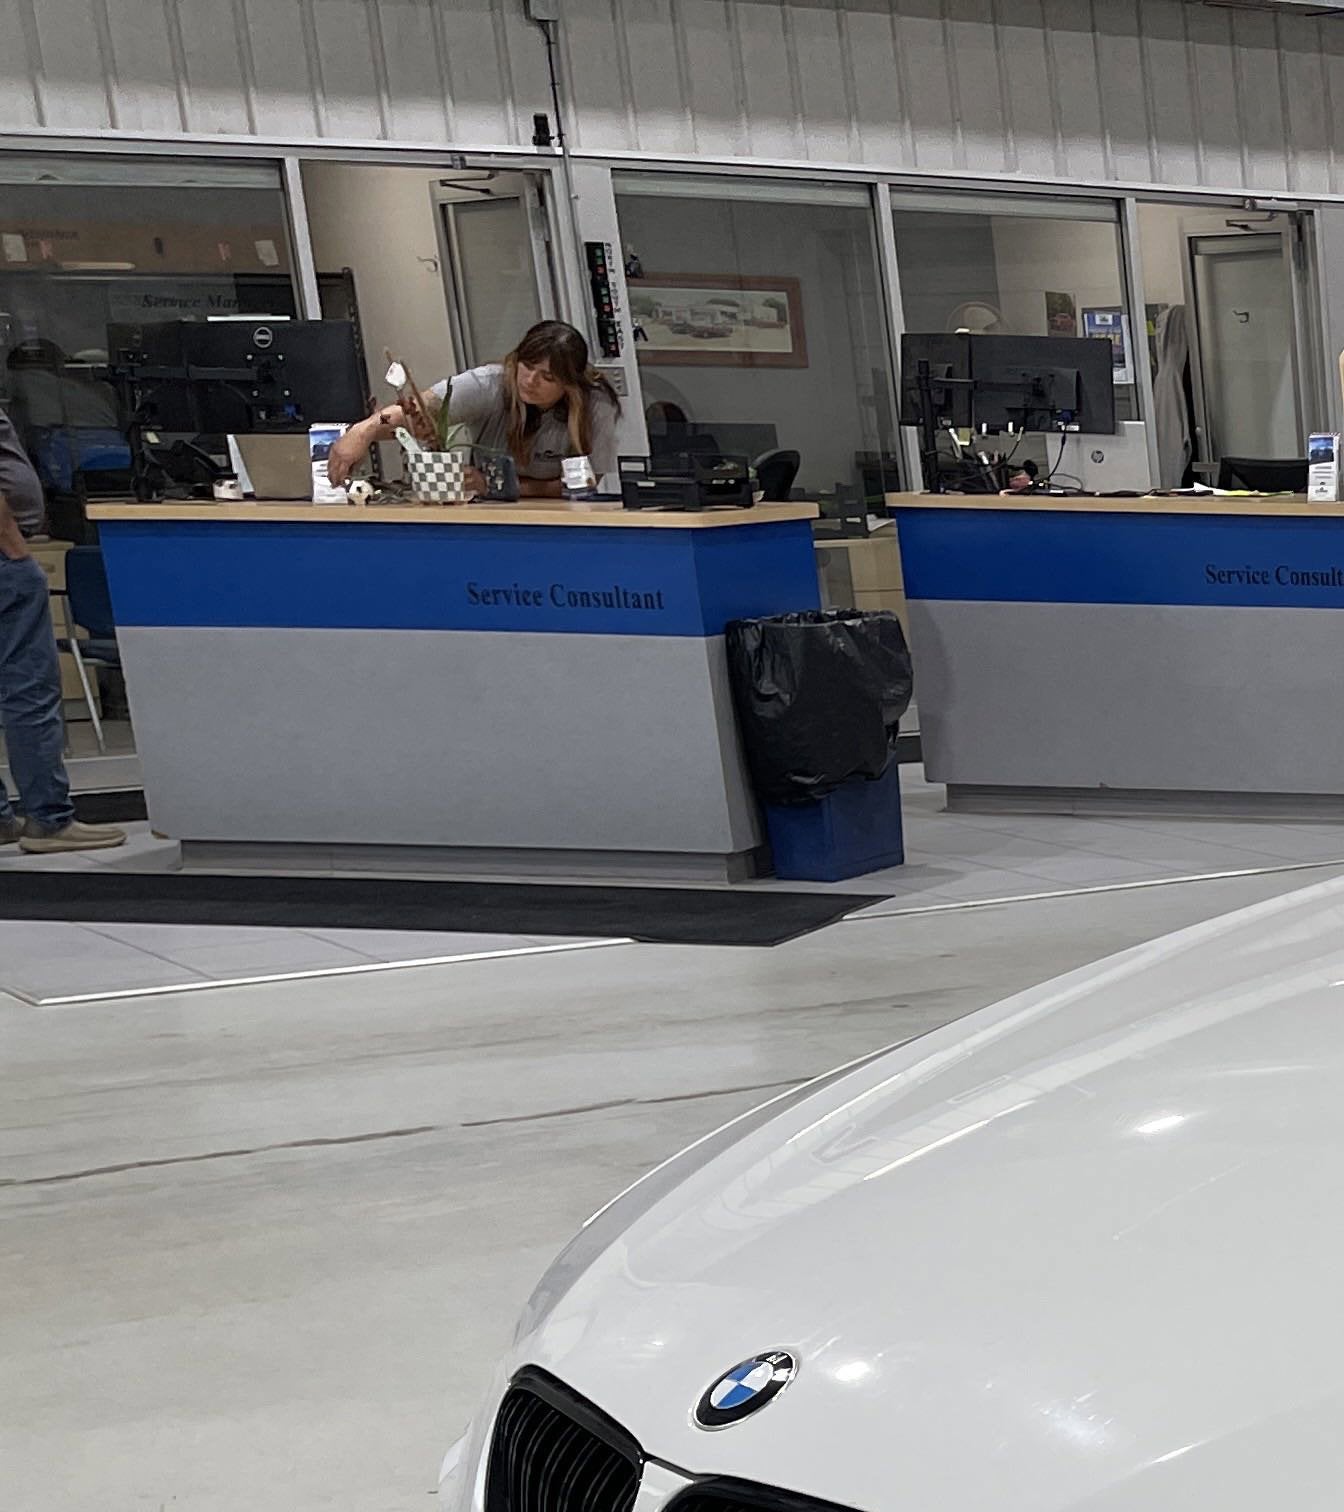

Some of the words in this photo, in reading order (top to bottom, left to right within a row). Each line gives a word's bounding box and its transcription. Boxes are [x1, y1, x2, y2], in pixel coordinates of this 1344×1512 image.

[1205, 563, 1269, 585] Service
[465, 581, 544, 607] Service
[550, 583, 665, 610] Consultant
